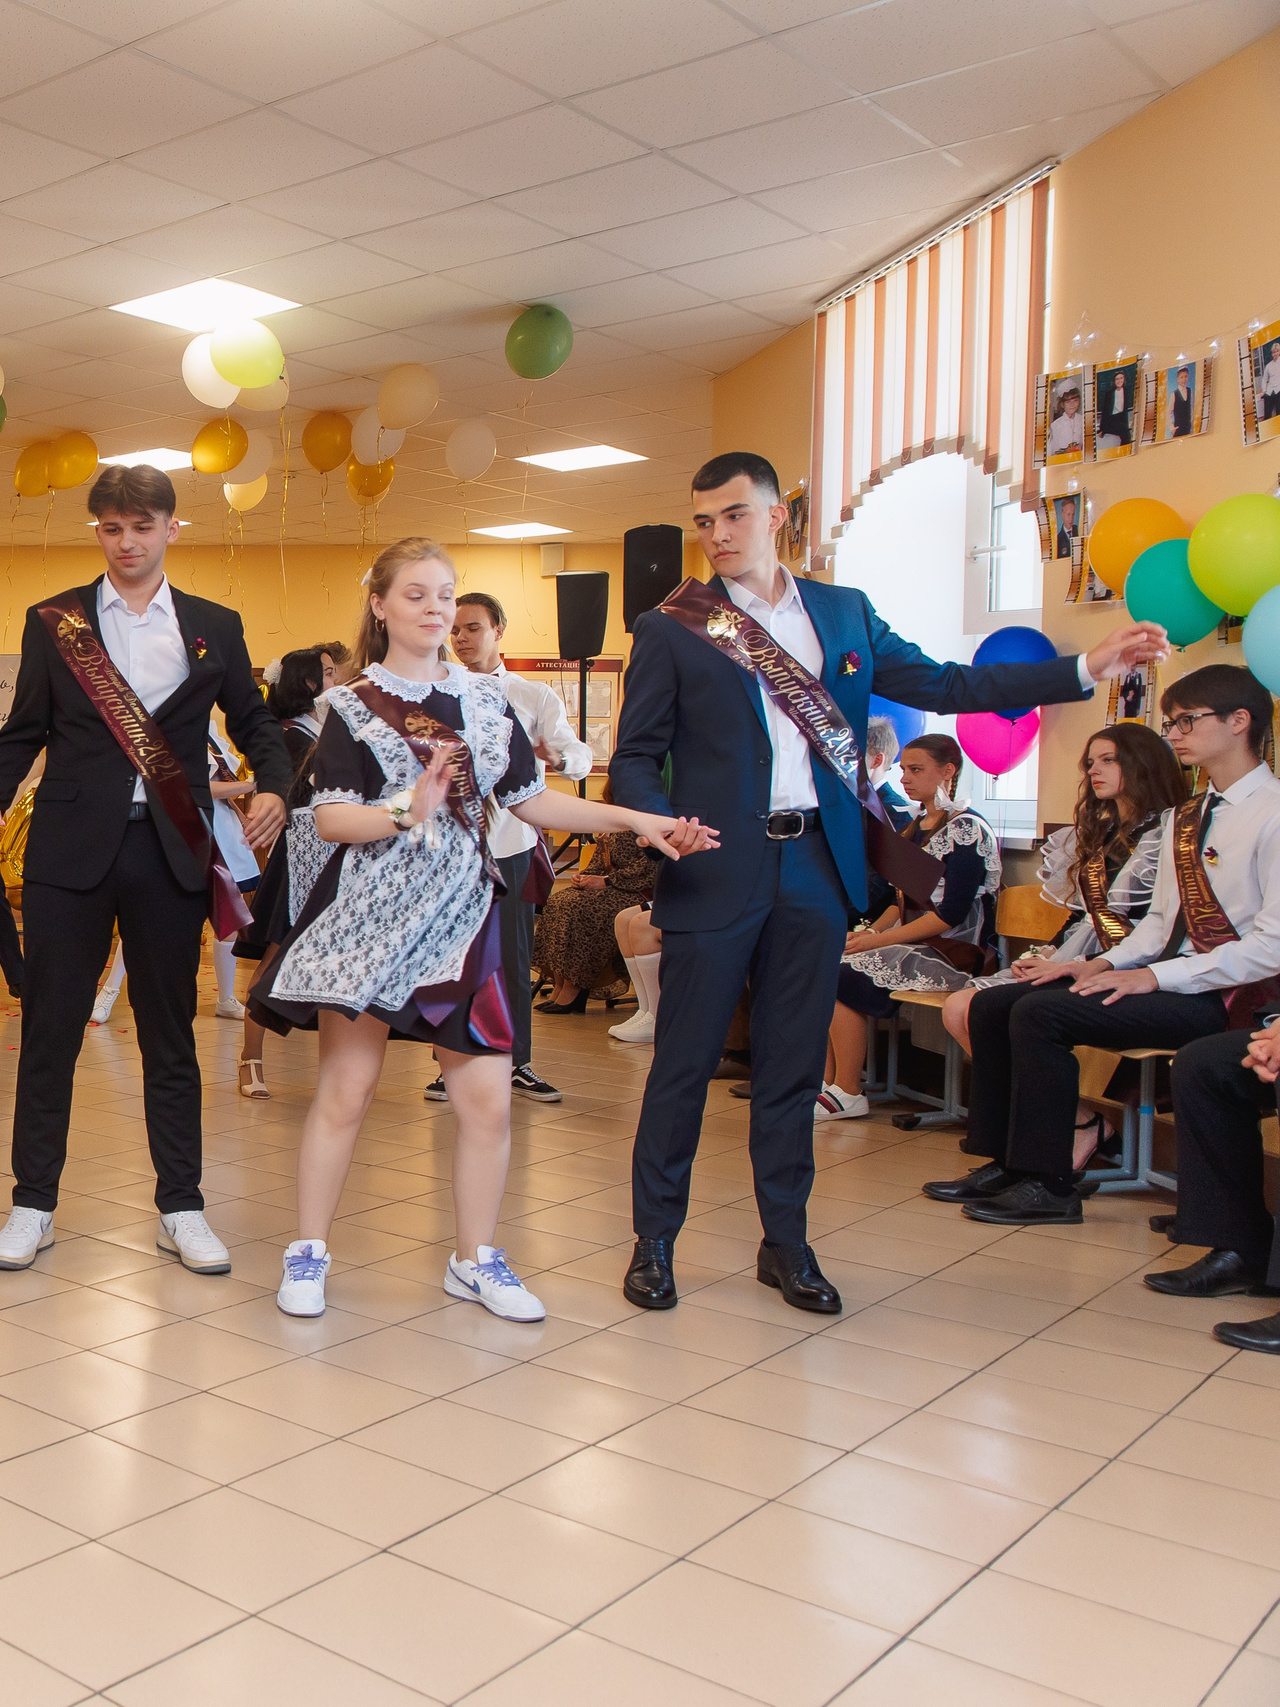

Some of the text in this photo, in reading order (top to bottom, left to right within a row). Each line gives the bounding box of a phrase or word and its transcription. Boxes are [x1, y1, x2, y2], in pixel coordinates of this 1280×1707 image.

[72, 636, 181, 782] Выпускник 2024
[736, 629, 863, 774] Выпускник 2024
[1176, 817, 1203, 905] Выпускник
[1190, 902, 1235, 941] 2024
